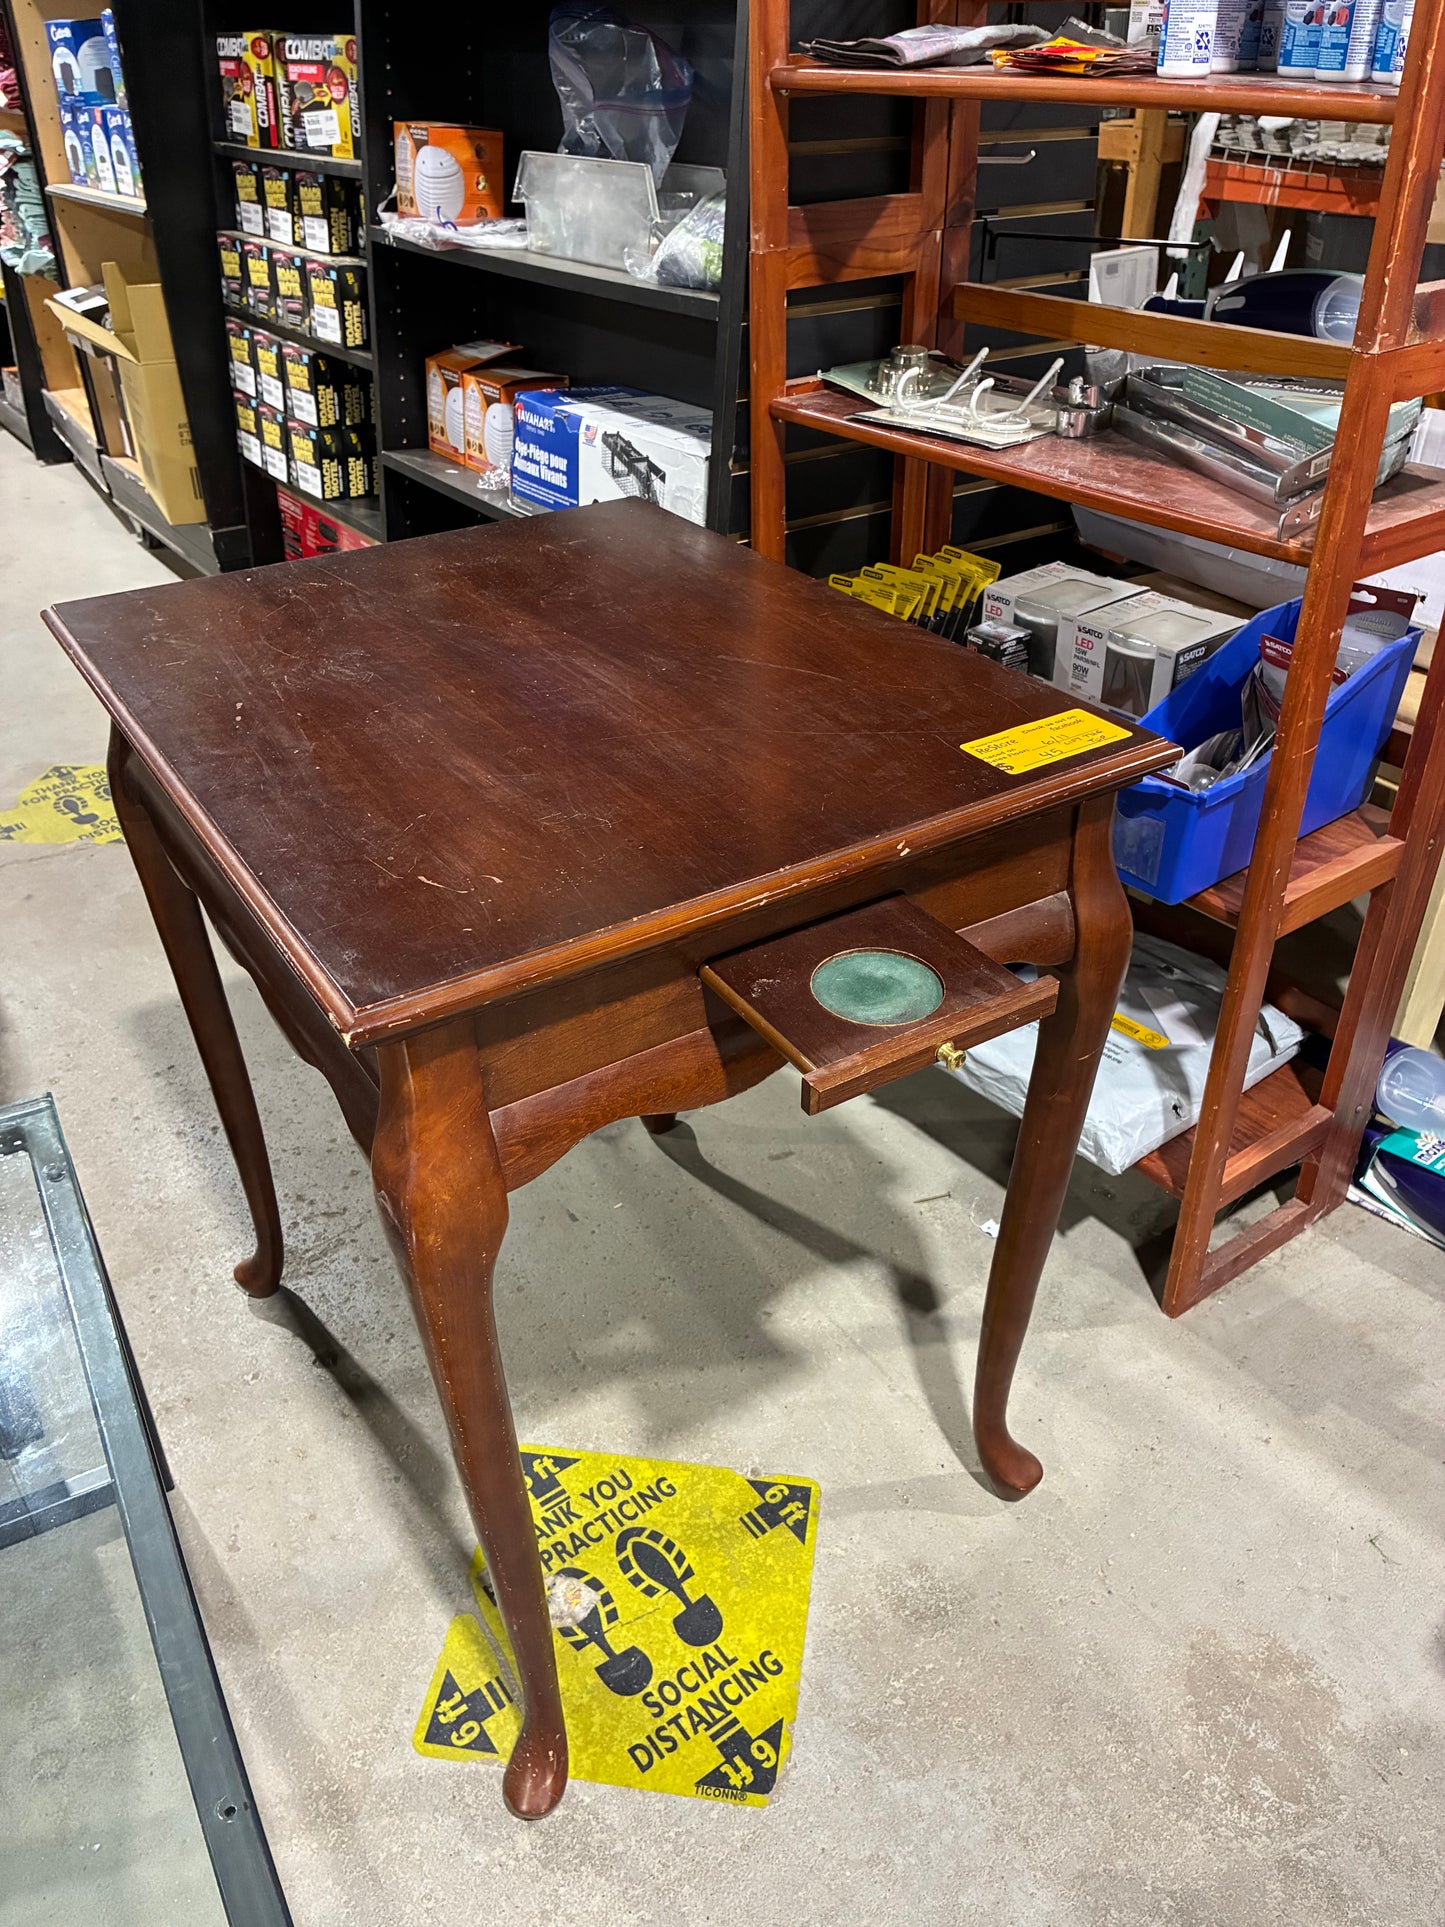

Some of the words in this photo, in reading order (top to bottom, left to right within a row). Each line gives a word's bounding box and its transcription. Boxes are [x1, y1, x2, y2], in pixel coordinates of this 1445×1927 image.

[253, 70, 269, 128] COMBAT
[347, 76, 361, 138] COMBAT
[330, 207, 341, 254] ROACH
[339, 208, 349, 253] MOTEL
[344, 300, 356, 347] ROACH
[353, 301, 364, 345] MOTEL
[1245, 380, 1282, 389] LIDO
[1283, 384, 1324, 394] Closet
[317, 385, 329, 428] ROACH
[326, 385, 337, 426] MOTEL
[322, 459, 333, 500] ROACH
[330, 458, 341, 498] MOTEL
[348, 456, 359, 498] ROACH
[356, 456, 366, 496] MOTEL
[540, 464, 568, 489] Vivants
[549, 452, 568, 472] pour
[985, 603, 1003, 617] LED
[990, 594, 1011, 607] SATCO
[1074, 635, 1095, 651] LED
[1081, 626, 1104, 640] SATCO
[1270, 641, 1292, 656] SATCO
[1072, 662, 1089, 675] 90W
[1074, 647, 1088, 657] 15W
[1183, 647, 1206, 662] SATCO
[974, 739, 1019, 755] ReStore
[1039, 748, 1064, 758] 45
[22, 794, 51, 806] FOR
[53, 777, 108, 797] PRACTIC
[90, 815, 118, 830] SOC
[532, 1455, 561, 1480] ft
[534, 1500, 583, 1545] ANK
[579, 1469, 634, 1510] YOU
[764, 1484, 790, 1505] 6
[778, 1501, 808, 1527] ft
[540, 1476, 678, 1573] PRACTICING
[641, 1643, 739, 1719] SOCIAL
[435, 1690, 469, 1725] ft
[627, 1649, 784, 1774] DISTANCING
[450, 1720, 481, 1747] 6
[750, 1738, 778, 1769] 6
[719, 1754, 755, 1790] ft
